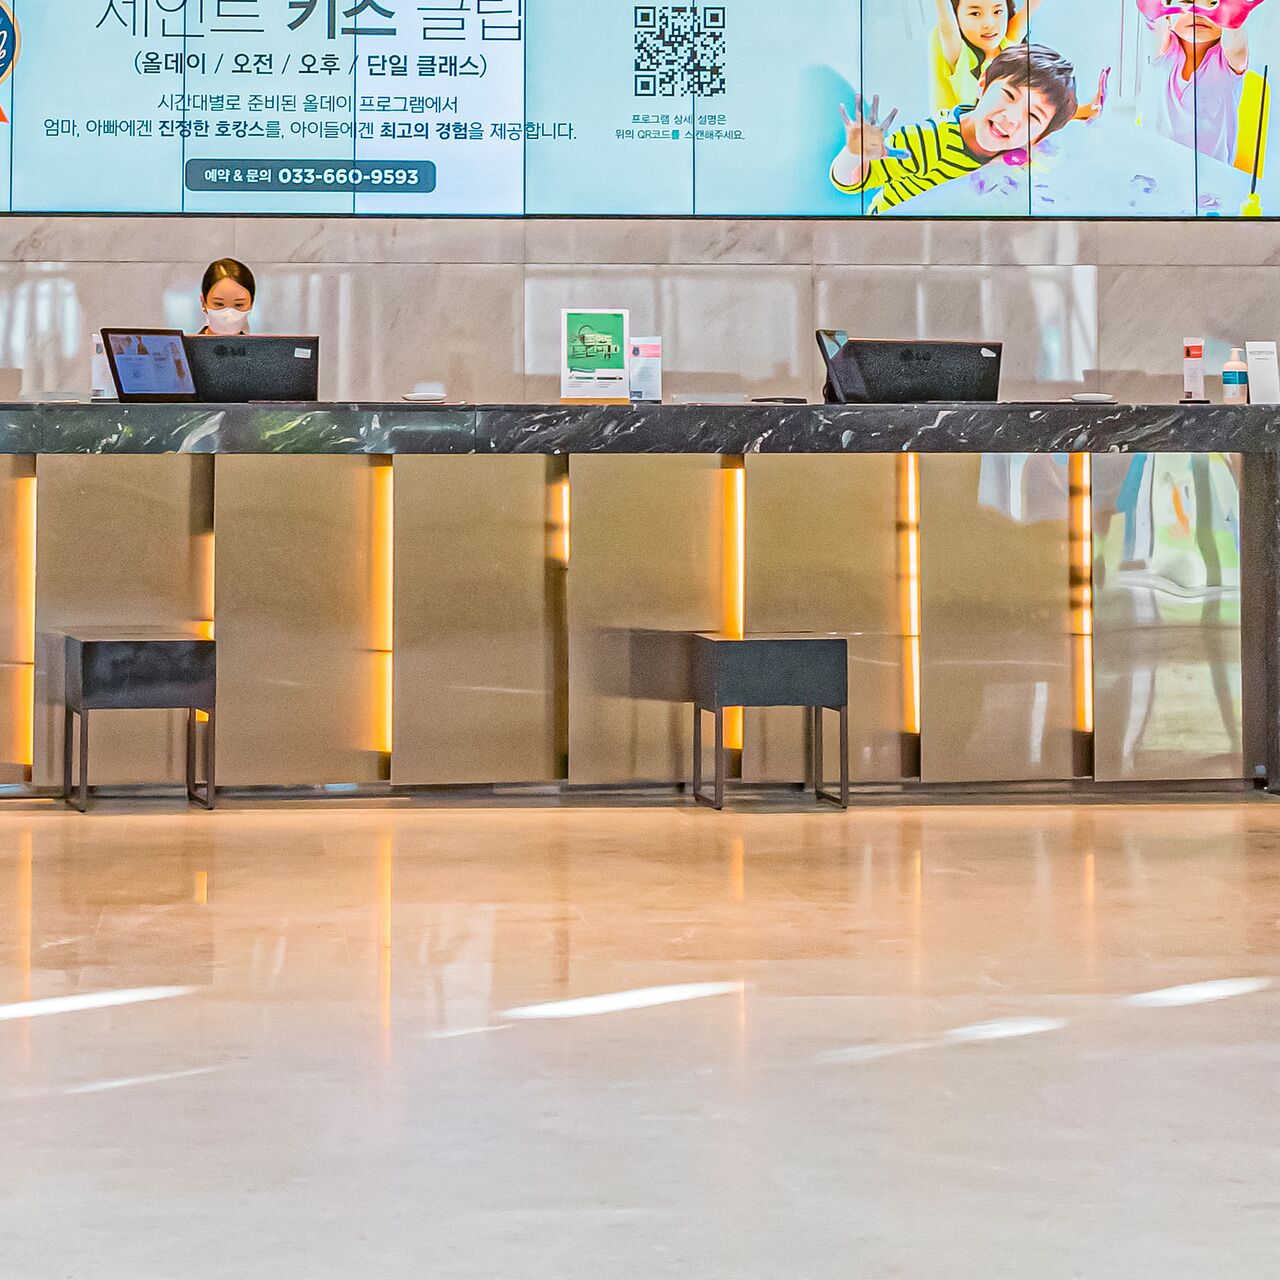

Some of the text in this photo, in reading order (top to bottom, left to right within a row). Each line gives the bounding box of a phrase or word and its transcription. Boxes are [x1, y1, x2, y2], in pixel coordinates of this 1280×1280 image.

[134, 51, 206, 75] (올데이
[214, 53, 224, 74] /
[231, 53, 273, 75] 오전
[281, 54, 291, 74] /
[298, 54, 340, 75] 오후
[367, 55, 408, 77] 단일
[417, 54, 487, 78] 클래스)
[157, 93, 458, 114] 시간대별로 준비된 올데이 프로그램에서
[631, 114, 670, 125] 프로그램
[698, 114, 727, 125] 설명은
[43, 119, 577, 141] 엄마, 아빠에겐 진정한 호캉스를, 아이들에겐 최고의 경험을 제공합니다.
[615, 129, 745, 140] 위의 QR코드 스캔해주세요.
[204, 168, 419, 185] 예약 & 문의 033-660-9593
